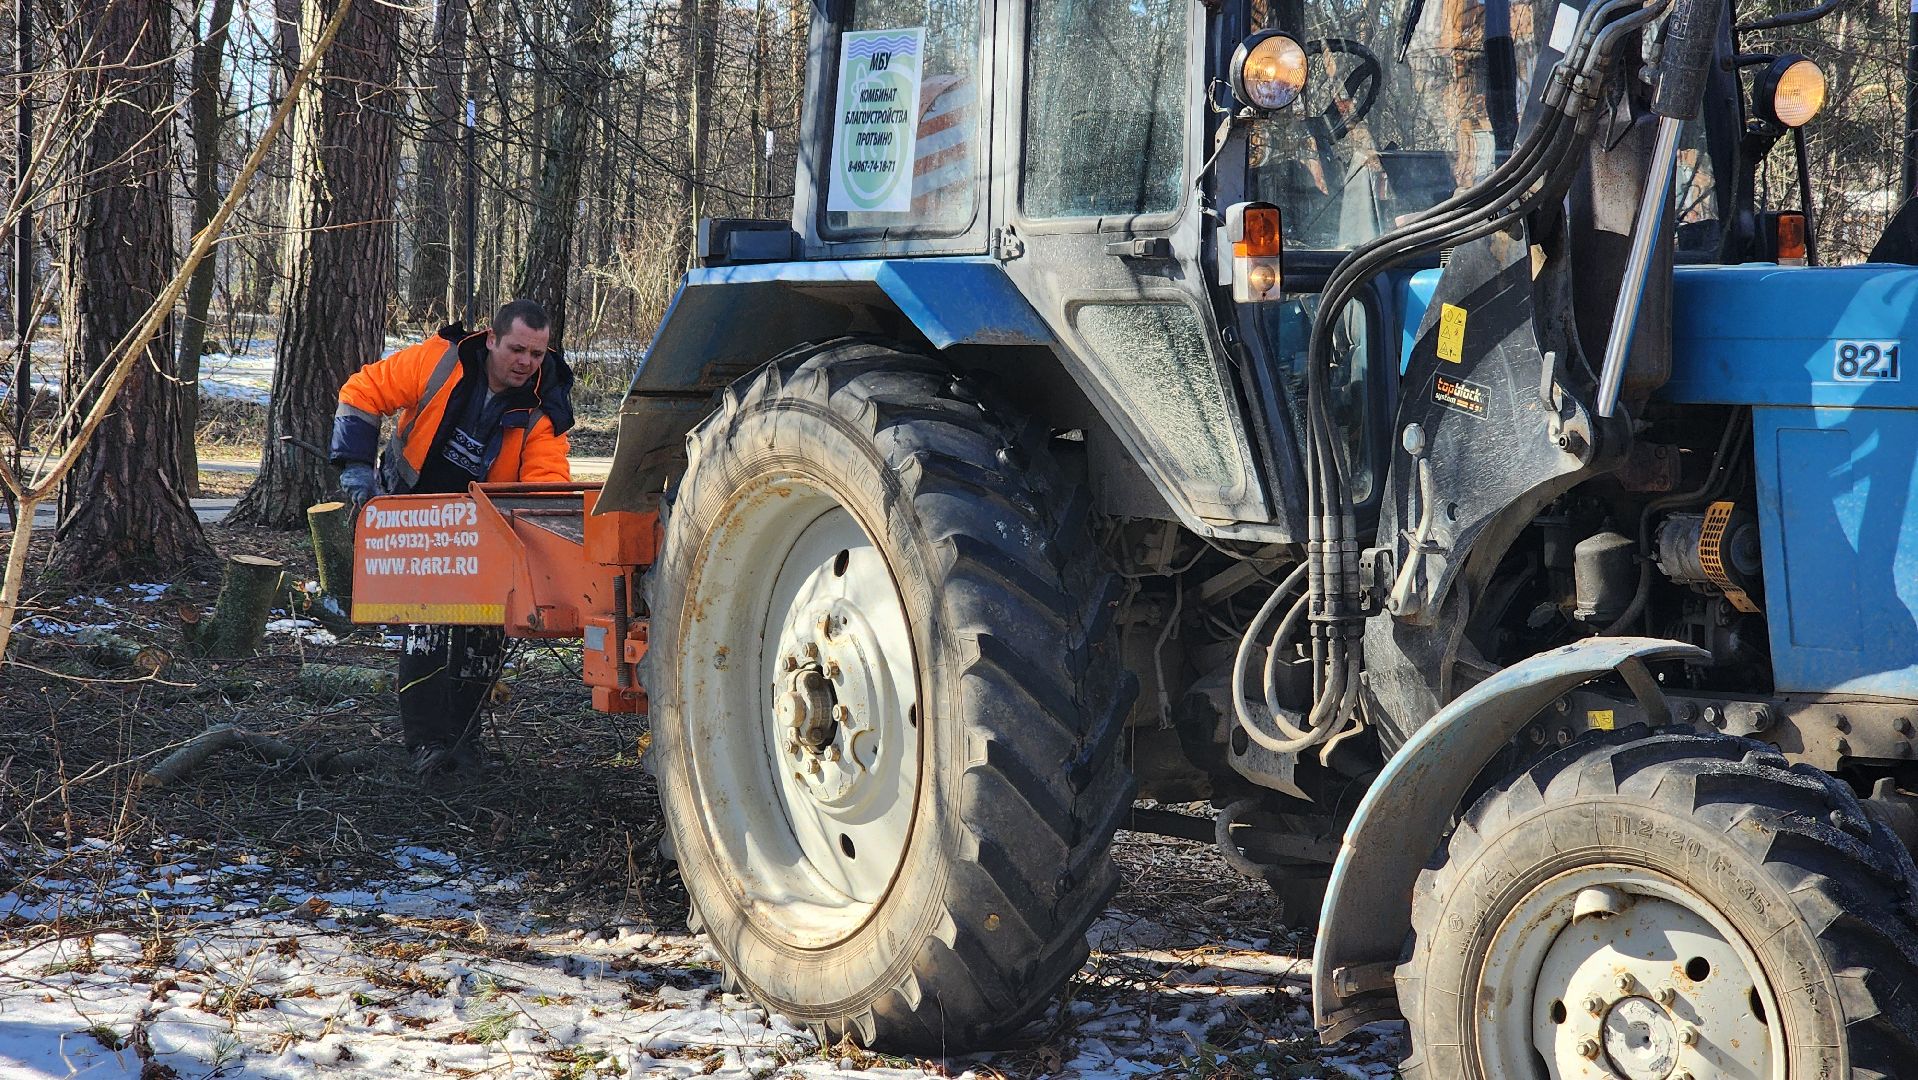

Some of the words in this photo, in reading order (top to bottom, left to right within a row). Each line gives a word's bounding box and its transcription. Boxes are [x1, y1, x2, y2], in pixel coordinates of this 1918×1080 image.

[869, 52, 892, 71] МБУ
[859, 88, 897, 103] КОМБИНАТ
[845, 107, 908, 125] БЛАГОУСТРОЙСТВА
[856, 132, 893, 146] ПРОТВИНО
[847, 160, 896, 173] 8-4967-74-18-71
[1838, 344, 1899, 378] 82.1
[1435, 392, 1457, 405] system
[365, 556, 479, 577] WWW.RARZ.RU
